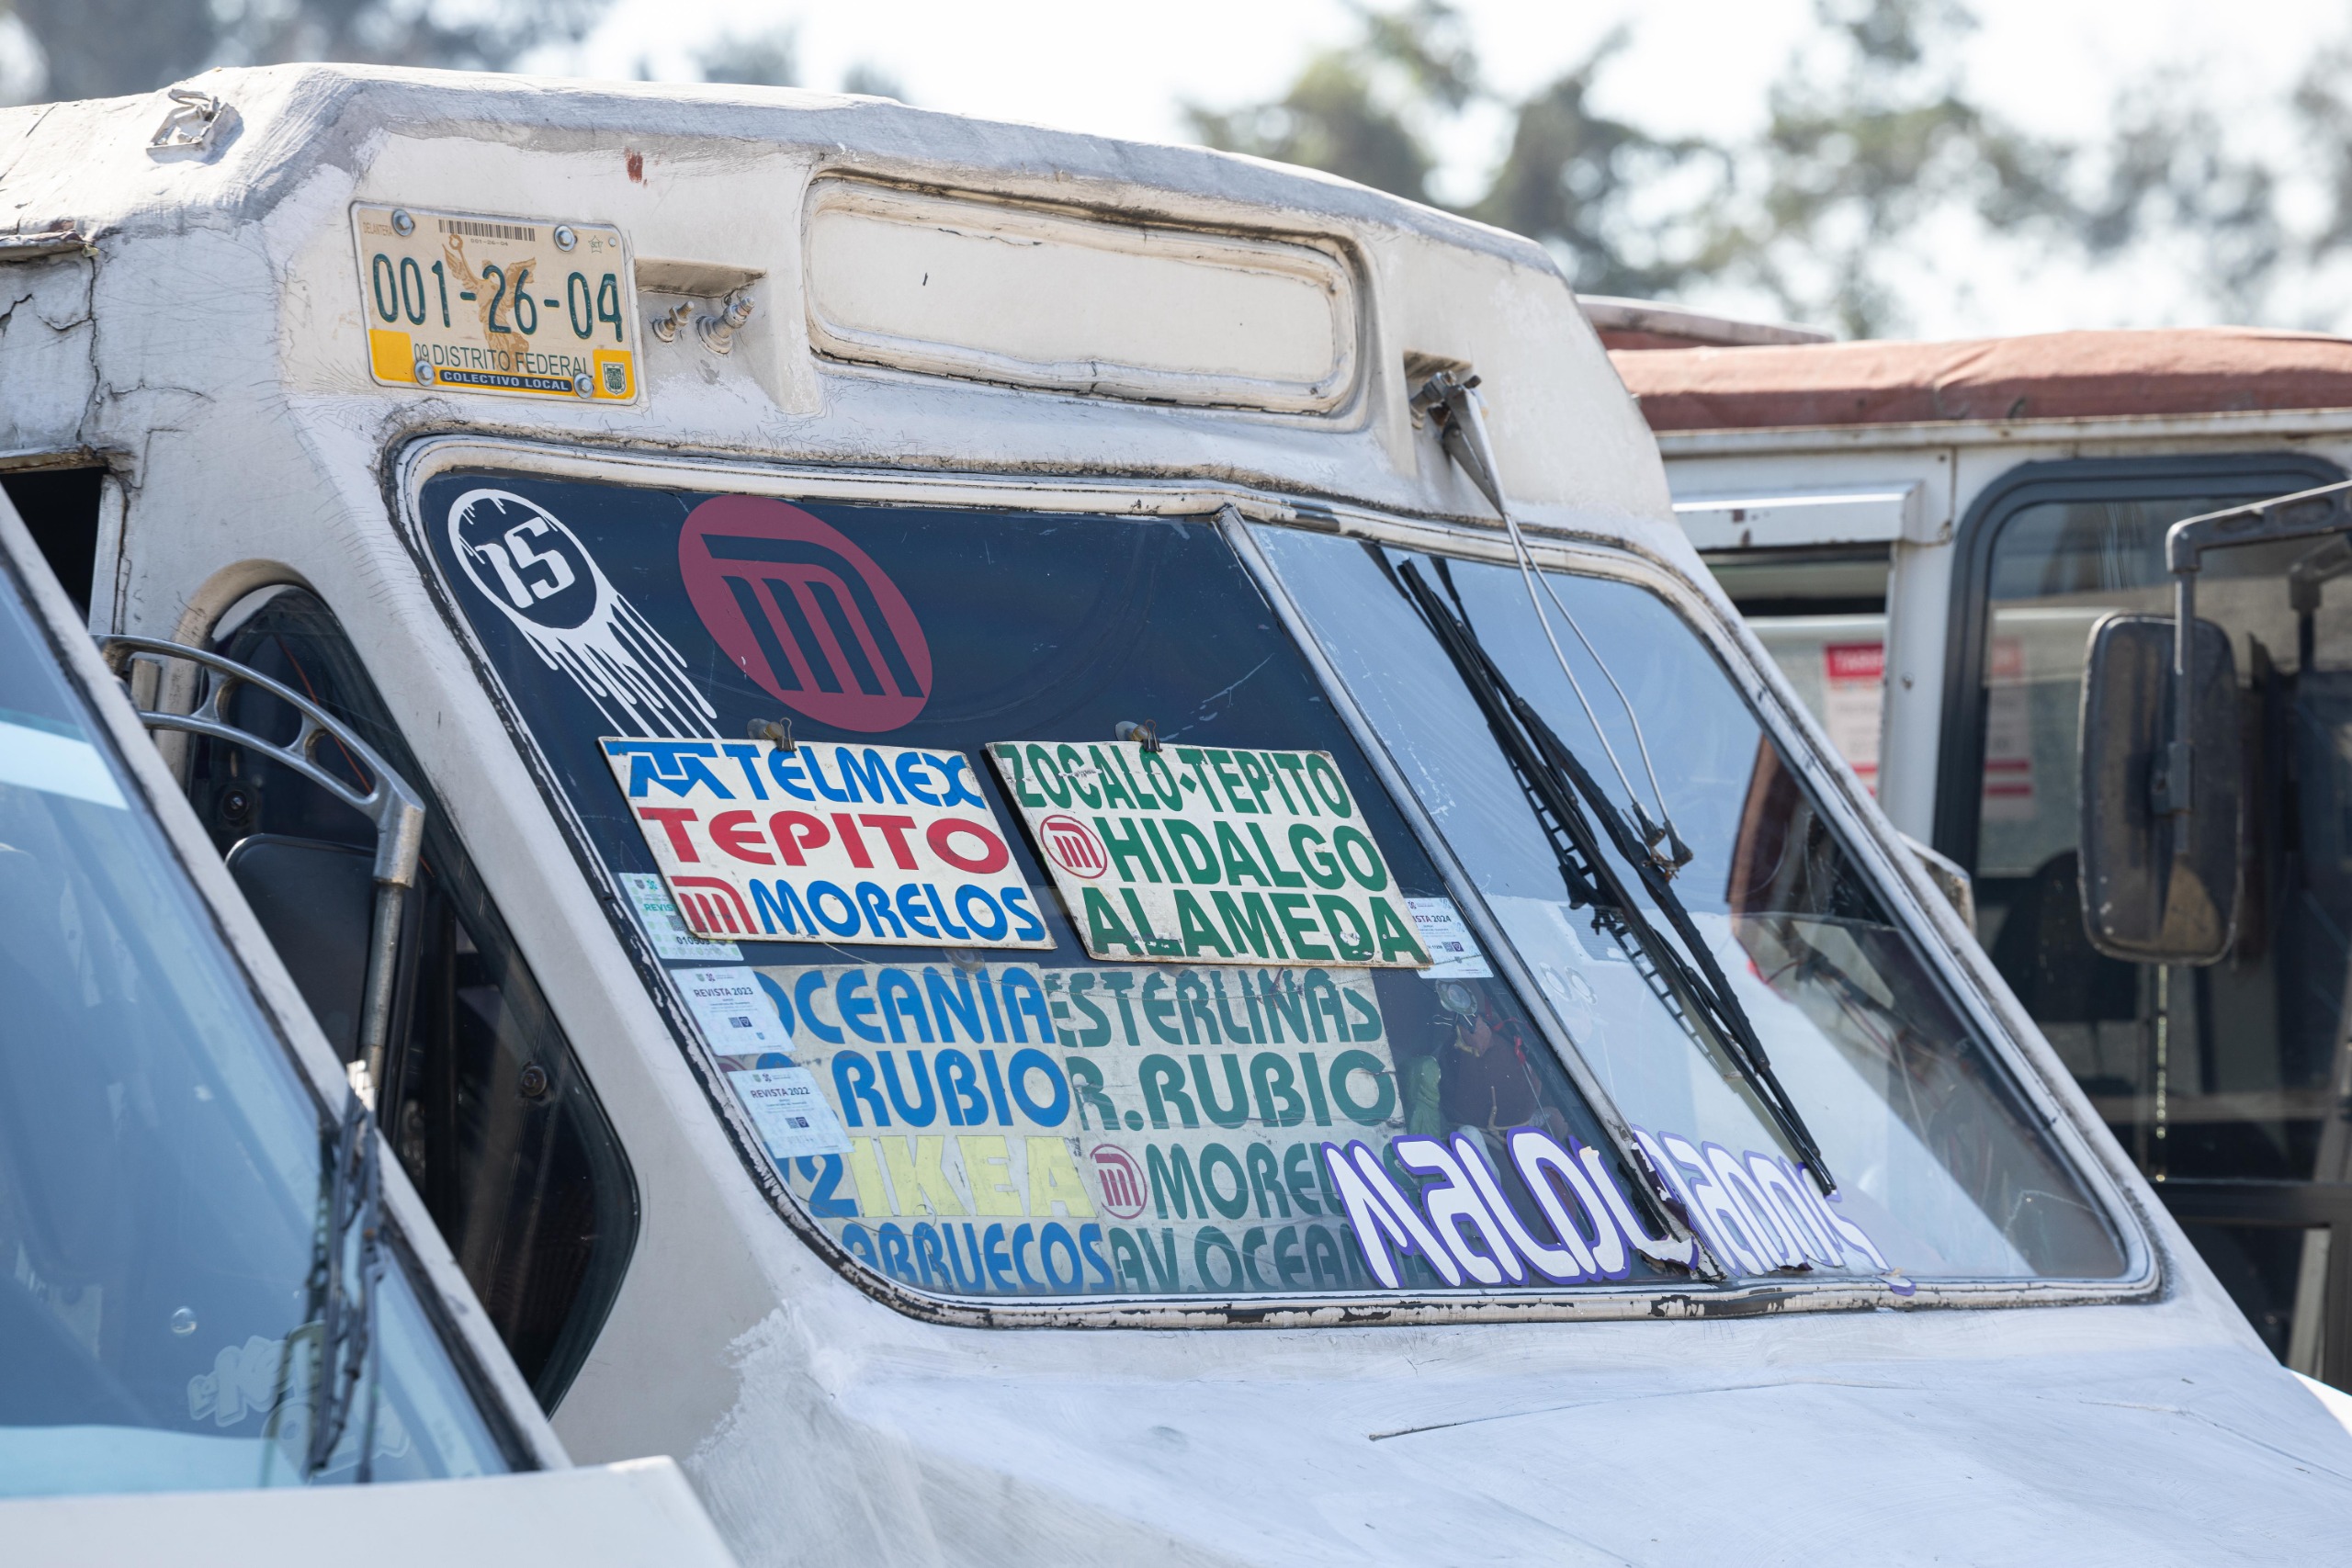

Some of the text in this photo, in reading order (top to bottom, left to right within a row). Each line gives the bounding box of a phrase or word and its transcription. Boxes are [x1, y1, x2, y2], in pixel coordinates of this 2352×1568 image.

[372, 253, 624, 343] 001-26-04
[433, 344, 511, 371] DISTRITO
[515, 352, 594, 378] FEDERAL
[444, 371, 569, 391] COLECTIVO LOCAL
[721, 744, 987, 809] TELMEX
[638, 807, 1009, 874] TEPITO
[1092, 817, 1387, 892] HIDALGO
[750, 878, 1046, 942] MORELOS
[1081, 886, 1427, 963] ALAMEDA
[1430, 915, 1452, 923] 2024
[693, 987, 753, 998] REVISTA 2023
[750, 1087, 810, 1099] REVISTA 2022
[847, 1135, 1098, 1218] IKEA
